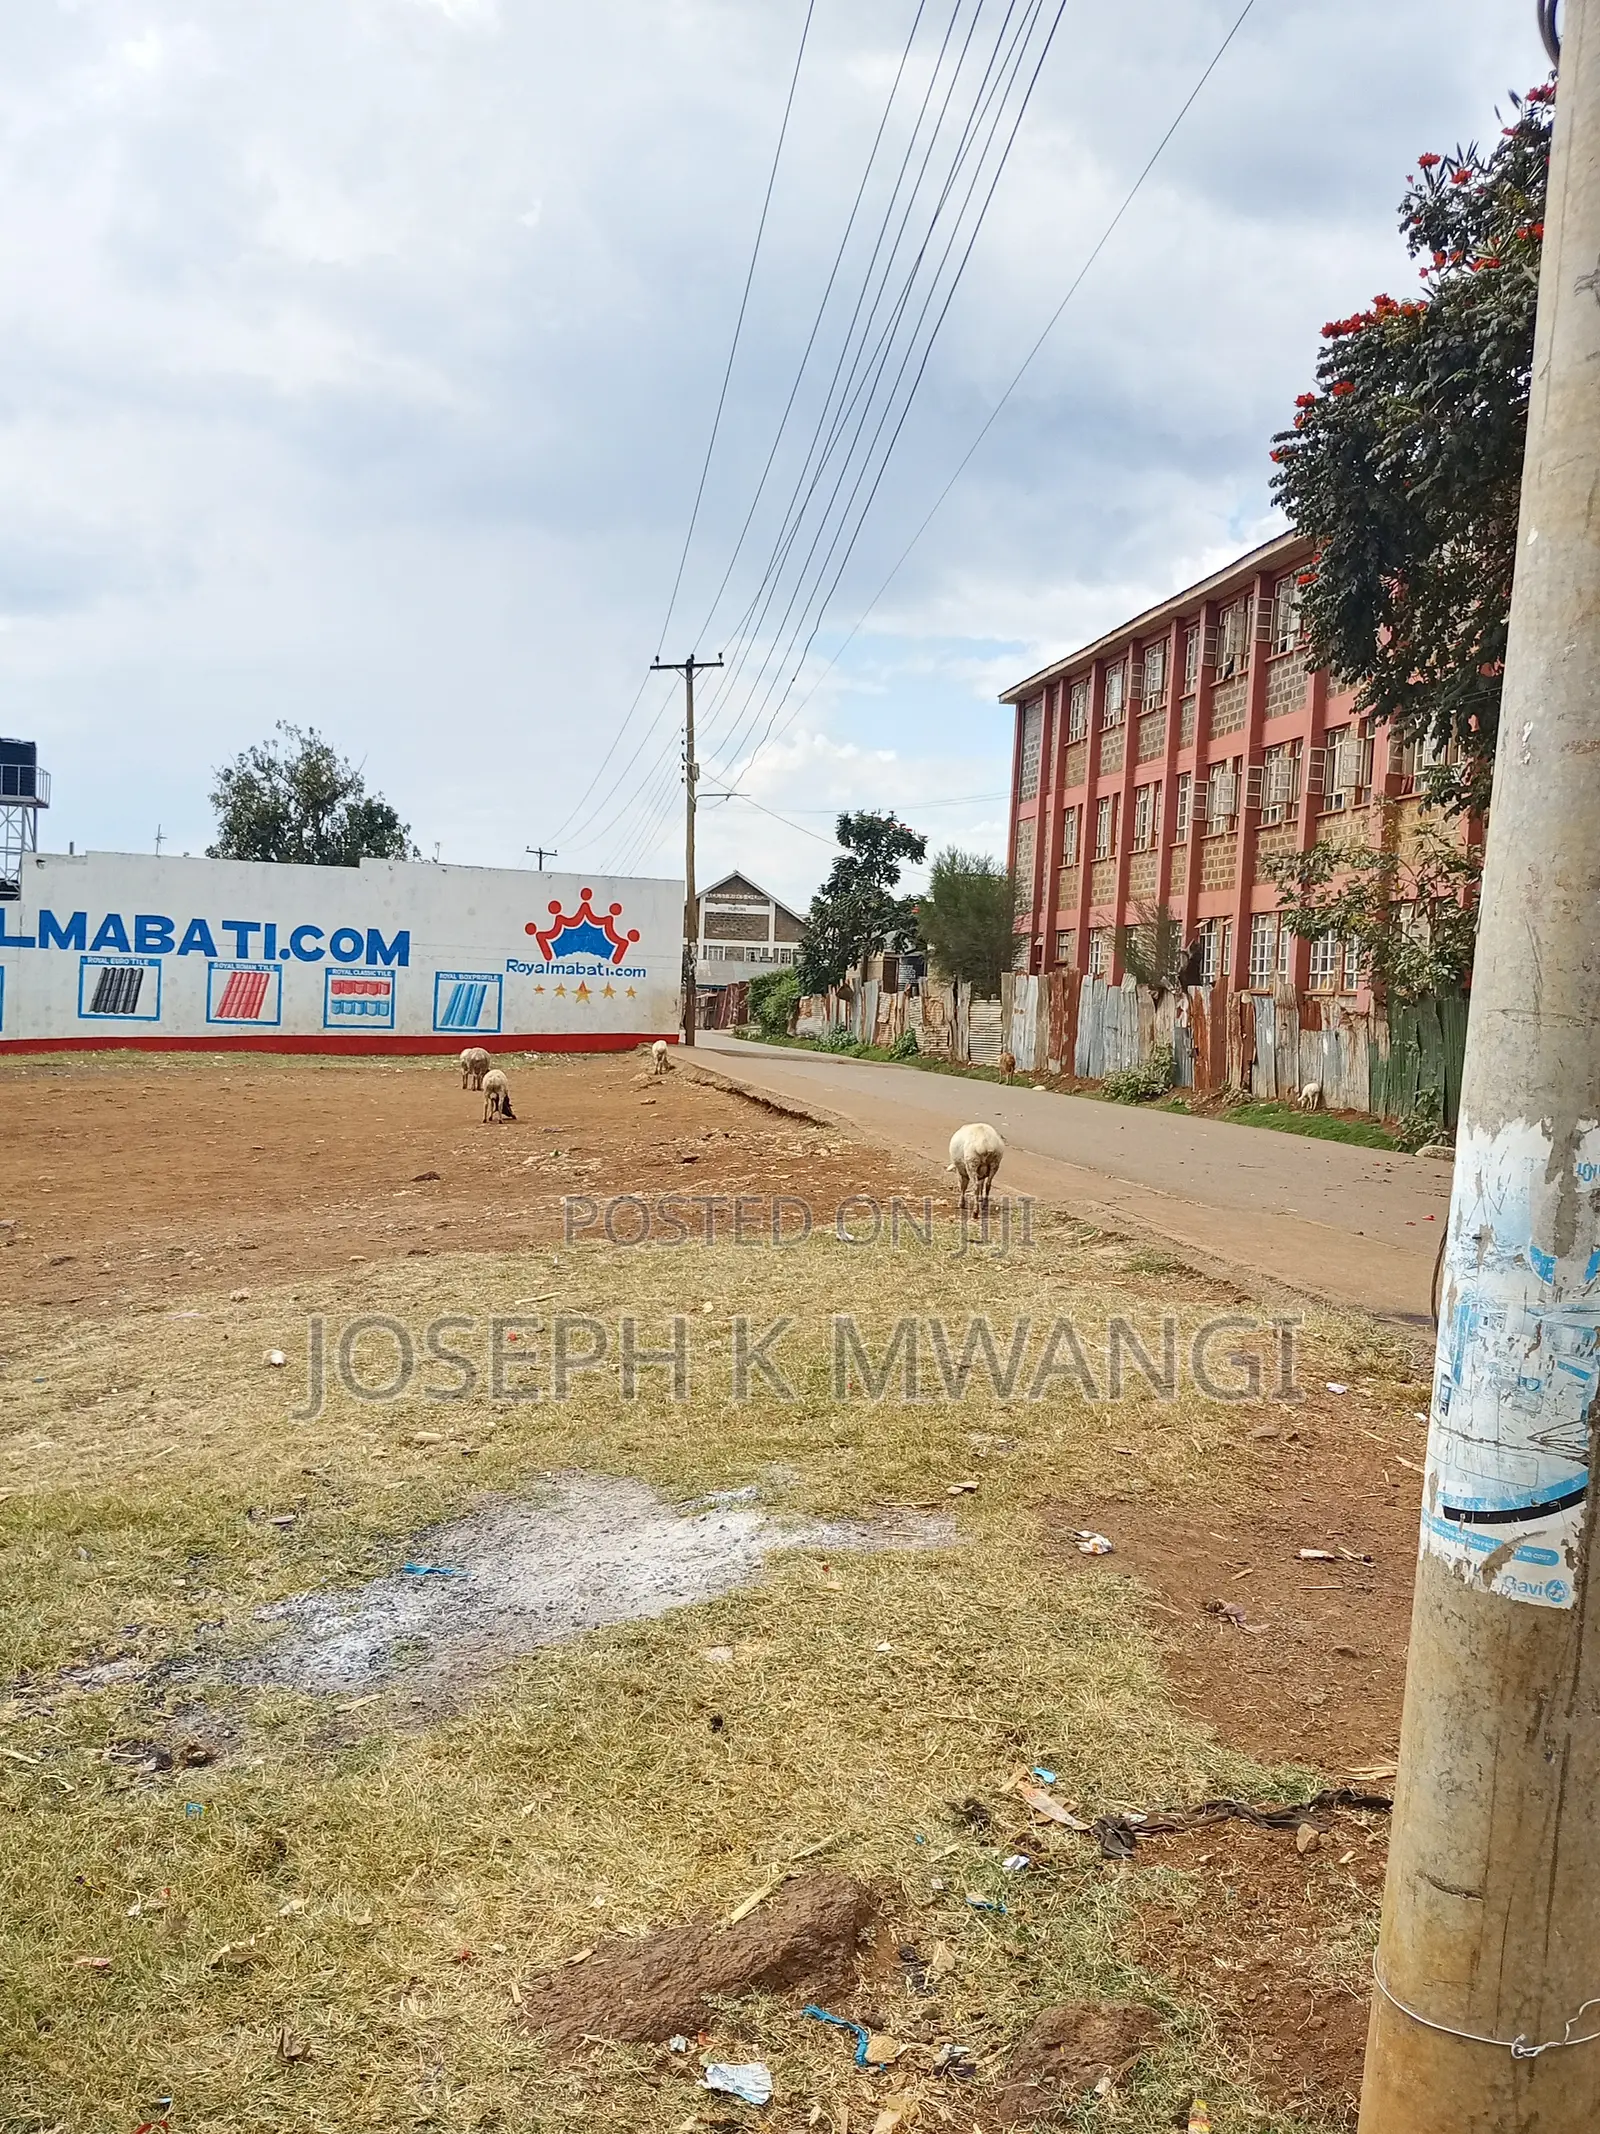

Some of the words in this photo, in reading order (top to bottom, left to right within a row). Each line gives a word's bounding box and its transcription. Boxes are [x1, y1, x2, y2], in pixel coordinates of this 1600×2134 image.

[87, 956, 109, 965] ROYAL
[110, 957, 129, 965] EURO
[130, 958, 149, 966] TILE
[213, 962, 235, 970] ROYAL
[506, 958, 647, 979] Royalmabati.com
[332, 968, 353, 976] ROYAL
[458, 973, 499, 982] BOXPROFILE
[1532, 1552, 1552, 1561] COST
